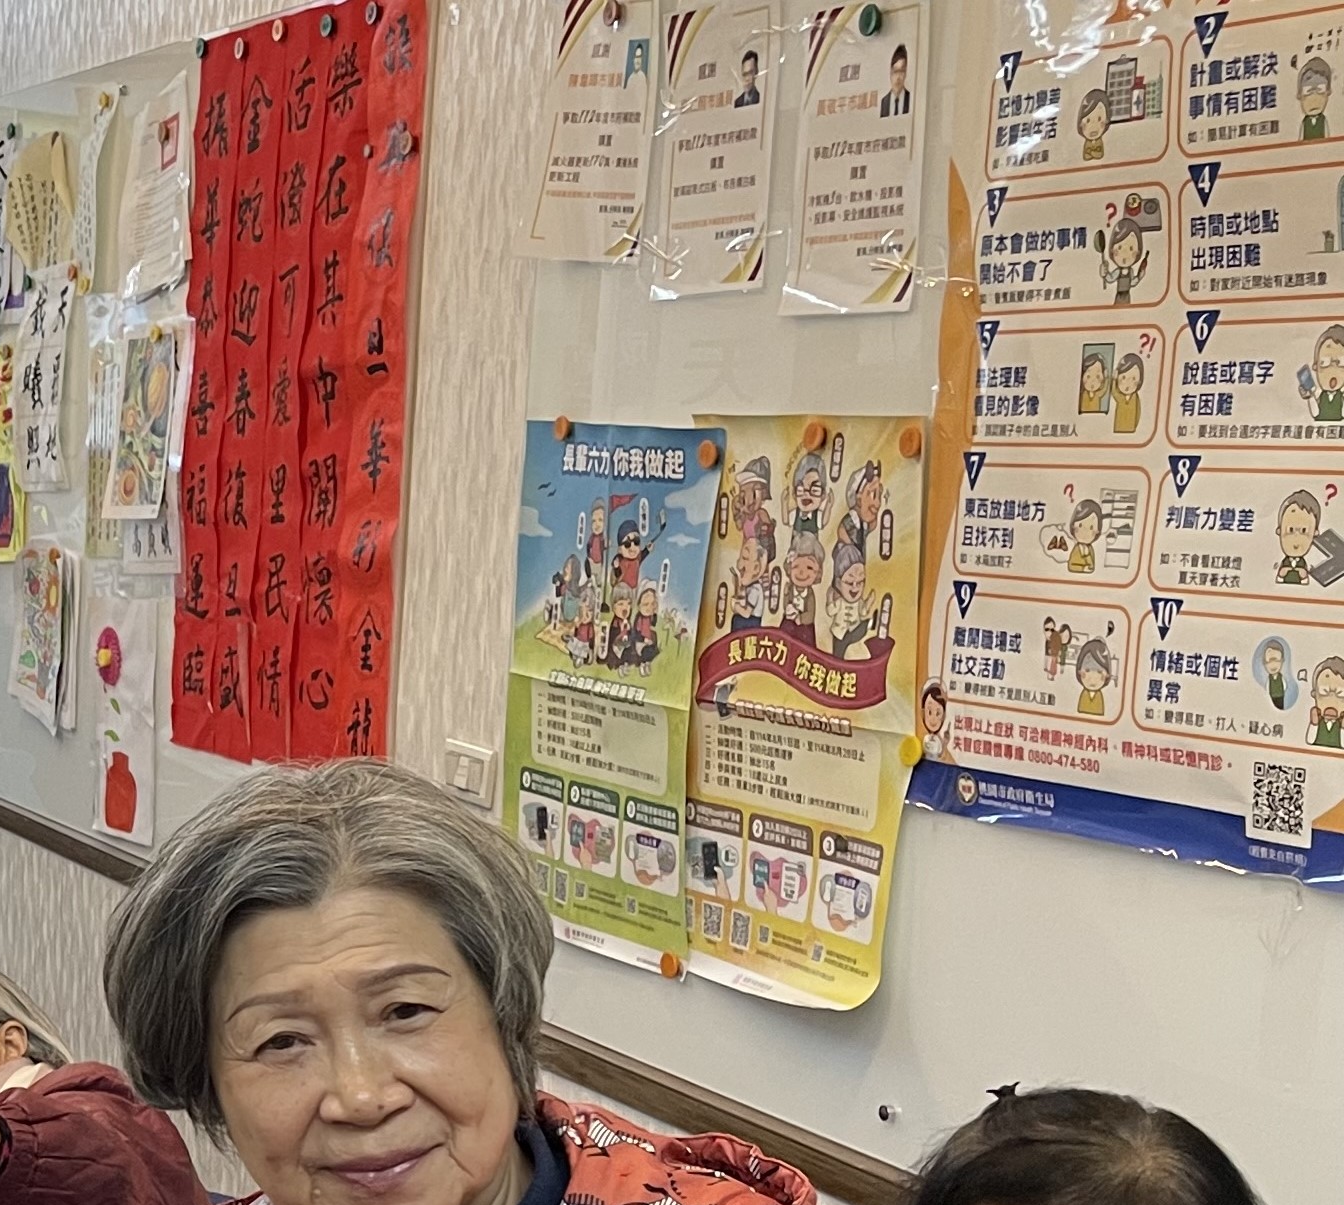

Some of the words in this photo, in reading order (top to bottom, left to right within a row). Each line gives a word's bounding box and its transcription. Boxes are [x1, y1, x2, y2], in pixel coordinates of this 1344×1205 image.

[1202, 16, 1217, 45] 2
[1189, 51, 1279, 88] 計畫或解決
[1189, 84, 1277, 120] 事情有困難
[1197, 166, 1212, 193] 4
[1190, 209, 1279, 239] 時間或地點
[980, 227, 1088, 258] 原本會做的事情
[1190, 243, 1261, 272] 出現困難
[979, 259, 1053, 286] 開始不會了
[981, 323, 993, 349] 5
[1194, 313, 1210, 341] 6
[298, 41, 362, 711] 樂在其中開懷心
[1182, 361, 1275, 386] 說話或寫字
[1180, 393, 1234, 417] 有困難
[562, 443, 611, 475] 長輩六力
[612, 447, 685, 480] 你我做起
[969, 454, 980, 480] 7
[1176, 458, 1191, 486] 8
[963, 498, 1047, 523] 東西放錯地方
[1165, 505, 1255, 533] 判斷力變差
[961, 525, 1014, 549] 且找不到
[960, 584, 971, 609] 9
[1156, 601, 1178, 628] 10
[952, 626, 1022, 654] 離開職場或
[728, 635, 788, 666] 長輩六力
[793, 653, 857, 699] 你我做起
[950, 653, 1006, 681] 社交活動
[1150, 648, 1240, 681] 情緒或個性
[1146, 678, 1182, 705] 異常
[1027, 749, 1101, 774] 0800-474-580
